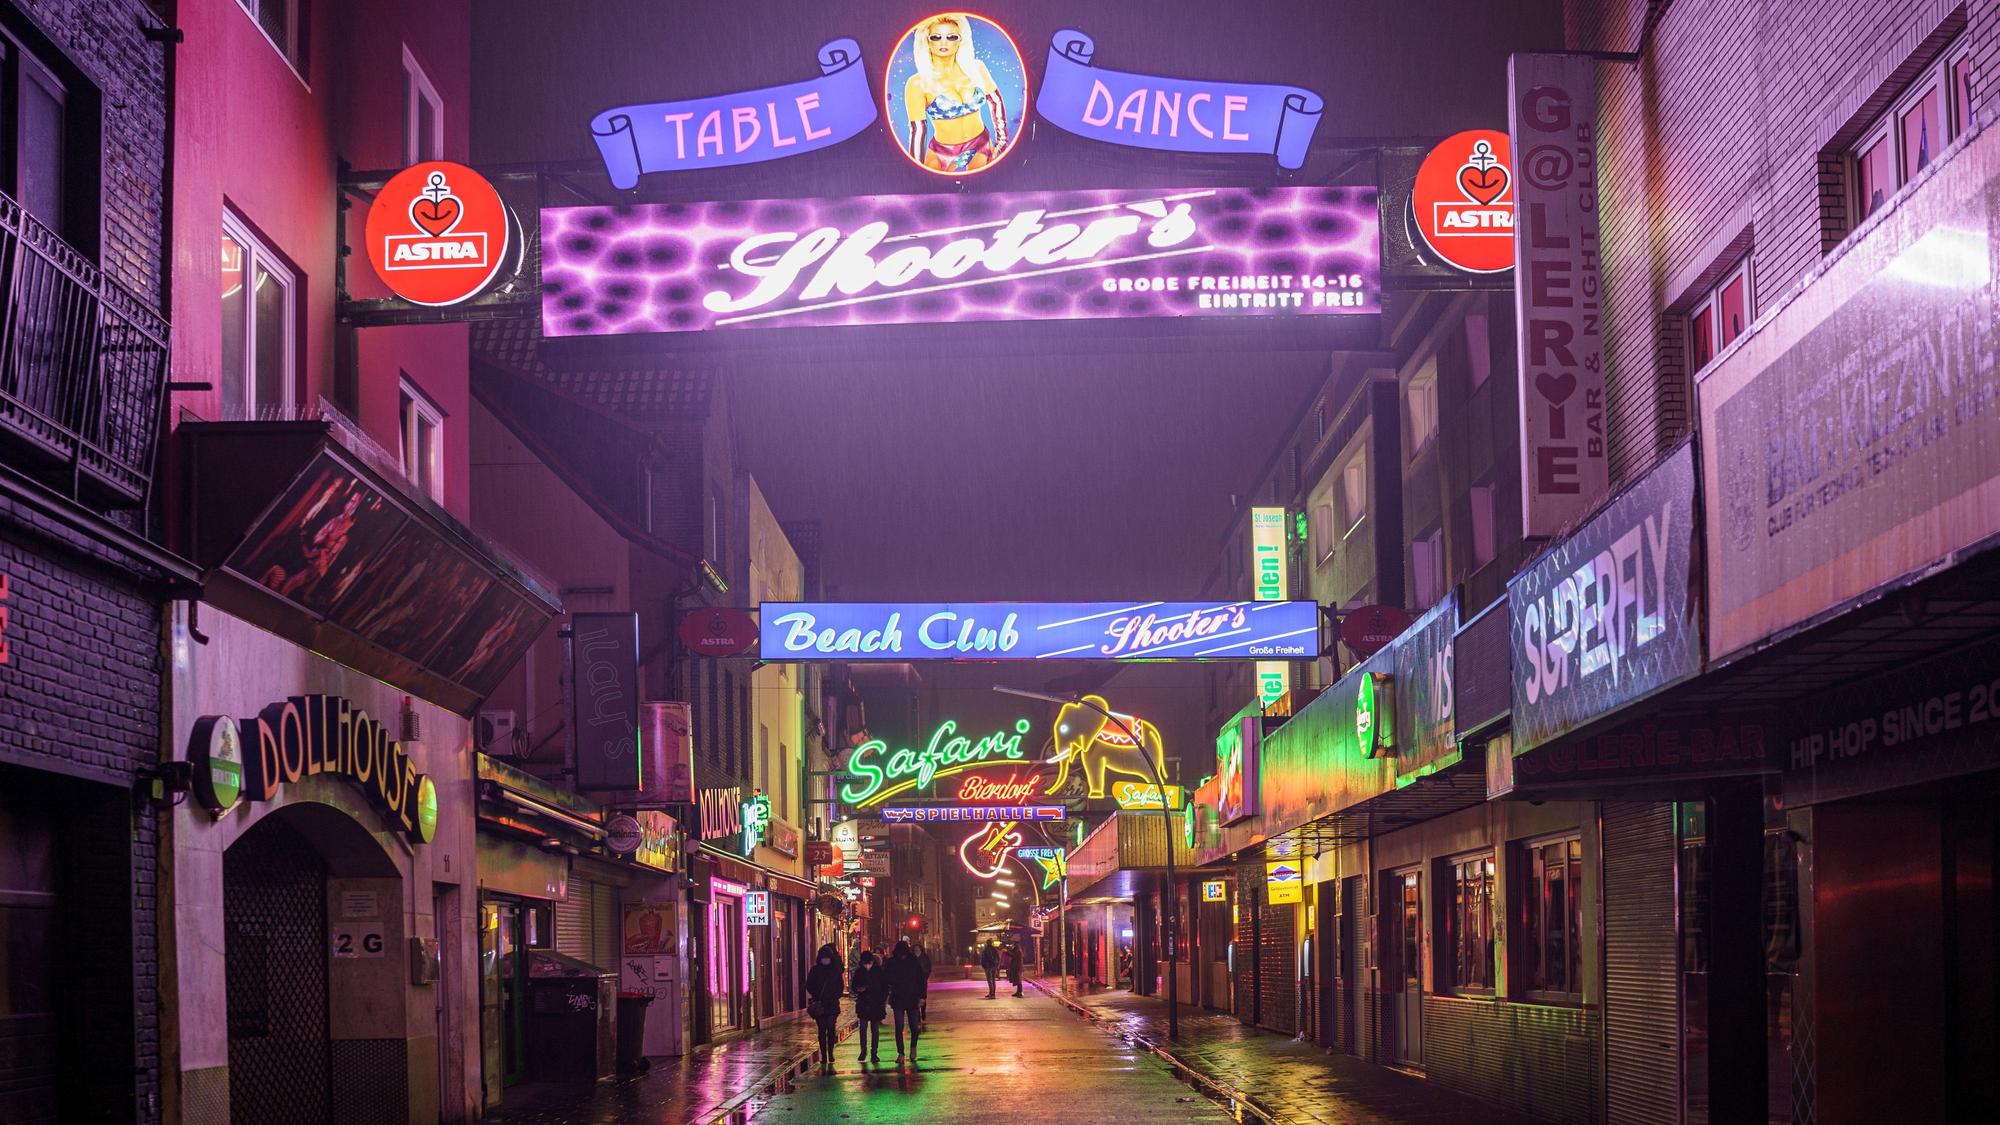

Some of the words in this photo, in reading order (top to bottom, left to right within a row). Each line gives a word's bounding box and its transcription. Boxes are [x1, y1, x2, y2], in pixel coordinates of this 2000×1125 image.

[665, 92, 832, 160] TABLE
[1082, 79, 1251, 142] DANCE
[1577, 122, 1594, 213] CLUB
[1443, 210, 1514, 228] ASTR
[393, 241, 479, 262] ASTRA
[1188, 275, 1293, 290] FREIHEIT
[1301, 274, 1363, 289] 14-16
[1199, 292, 1305, 308] EINTRITT
[1312, 291, 1364, 307] FREI
[1581, 226, 1599, 336] NIGHT
[1585, 352, 1600, 374] &
[1586, 388, 1603, 458] BAR
[699, 637, 736, 646] ASTRA
[772, 612, 904, 653] Beach
[917, 611, 1019, 653] Club
[1100, 605, 1247, 656] Shooter's
[1249, 646, 1275, 655] Große
[1275, 646, 1305, 655] Freiheit
[1791, 733, 1824, 771] HIP
[1829, 717, 1878, 761] HOP
[1882, 690, 1962, 747] SINCE
[256, 694, 417, 832] DOLLHOUSE
[841, 719, 1031, 804] Safari
[959, 772, 1041, 805] Bierdorf
[699, 786, 742, 841] DOLLHOUSE
[914, 808, 1034, 821] SPIELHALLE
[746, 916, 766, 924] ATM
[337, 933, 353, 954] 2
[363, 933, 383, 953] G
